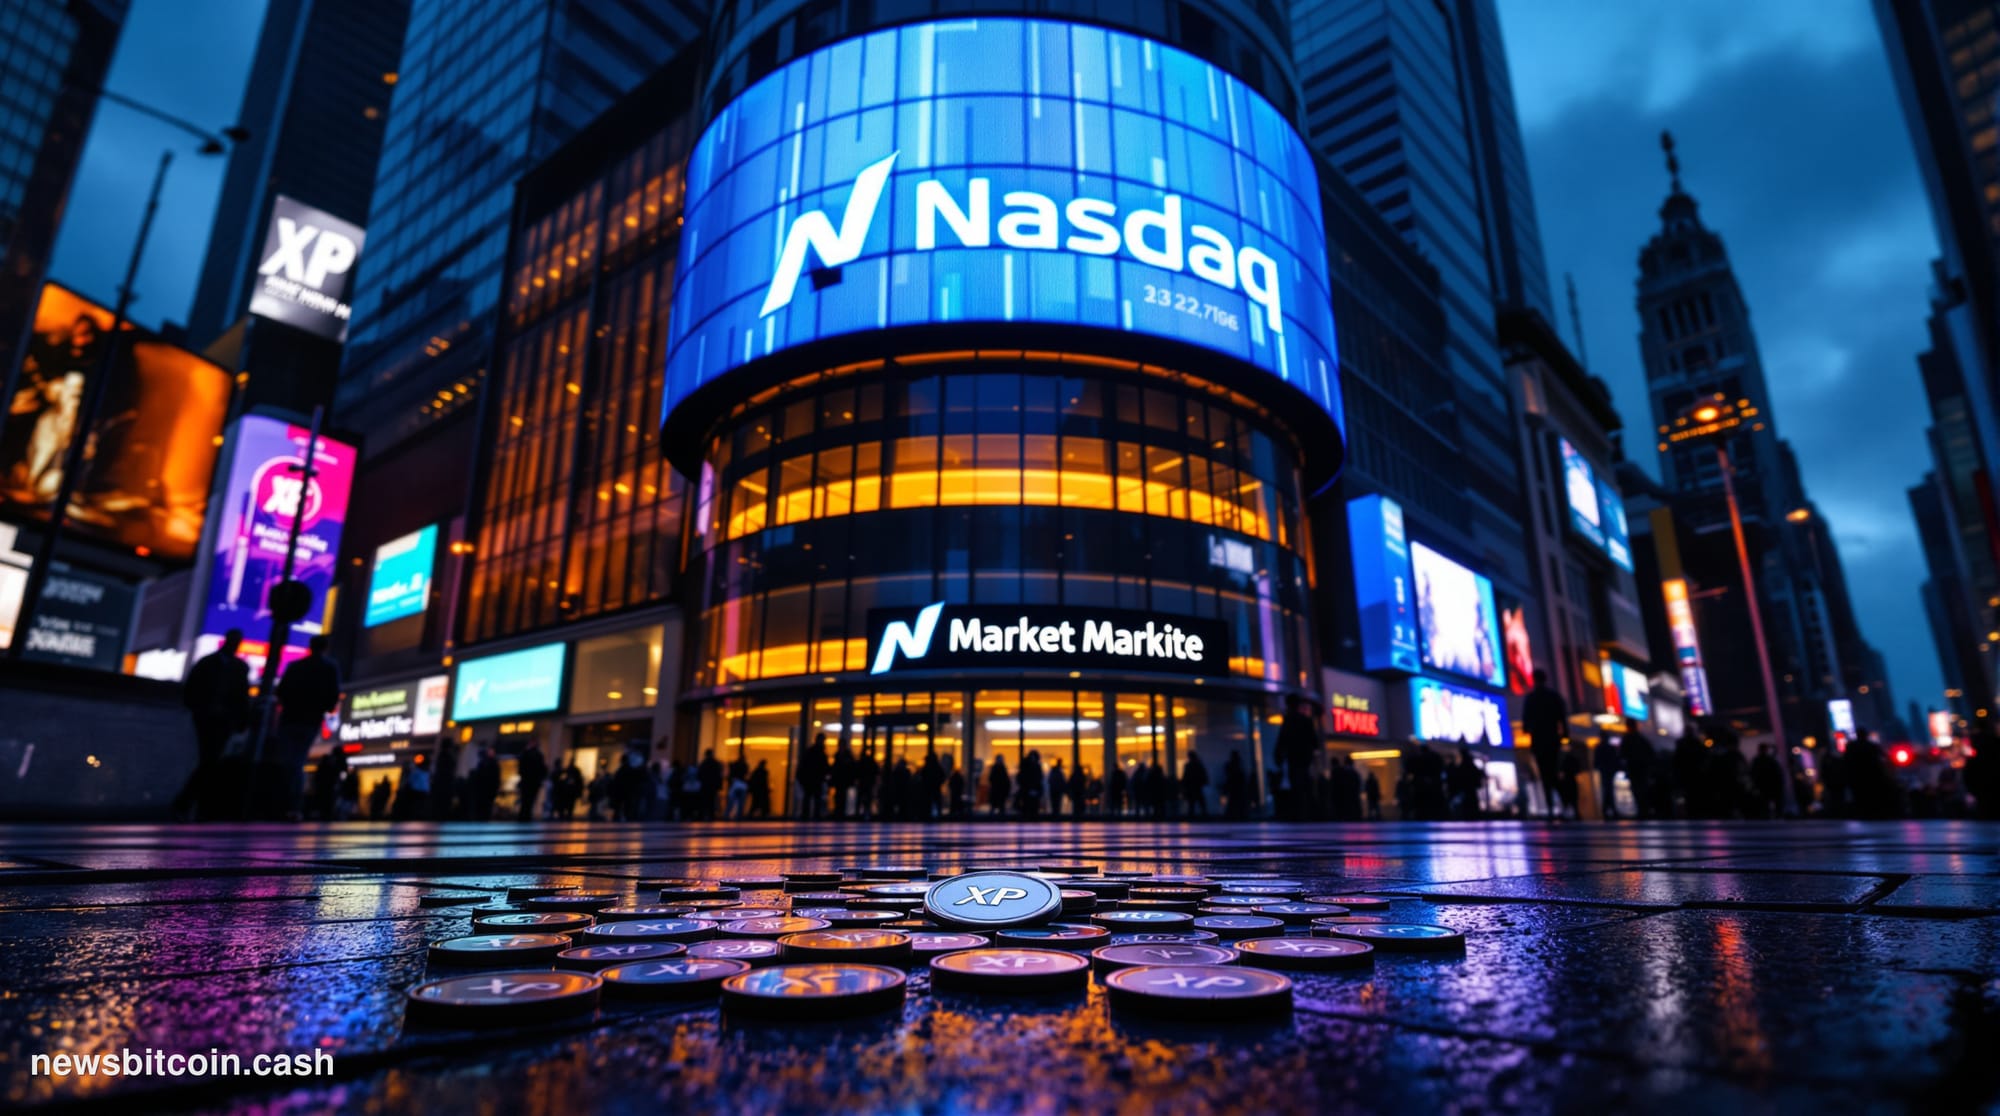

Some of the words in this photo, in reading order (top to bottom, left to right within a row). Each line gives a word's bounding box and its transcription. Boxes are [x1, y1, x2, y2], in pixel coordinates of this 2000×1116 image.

[258, 217, 357, 289] XP
[915, 177, 1284, 335] Nasdaq
[949, 616, 1077, 653] Market
[1082, 619, 1205, 662] Markite
[954, 886, 1028, 906] XP
[594, 944, 653, 957] XP
[1271, 940, 1338, 953] XP
[647, 962, 721, 976] XP
[978, 955, 1049, 968] XP
[463, 978, 562, 995] XP
[1155, 972, 1246, 989] XP
